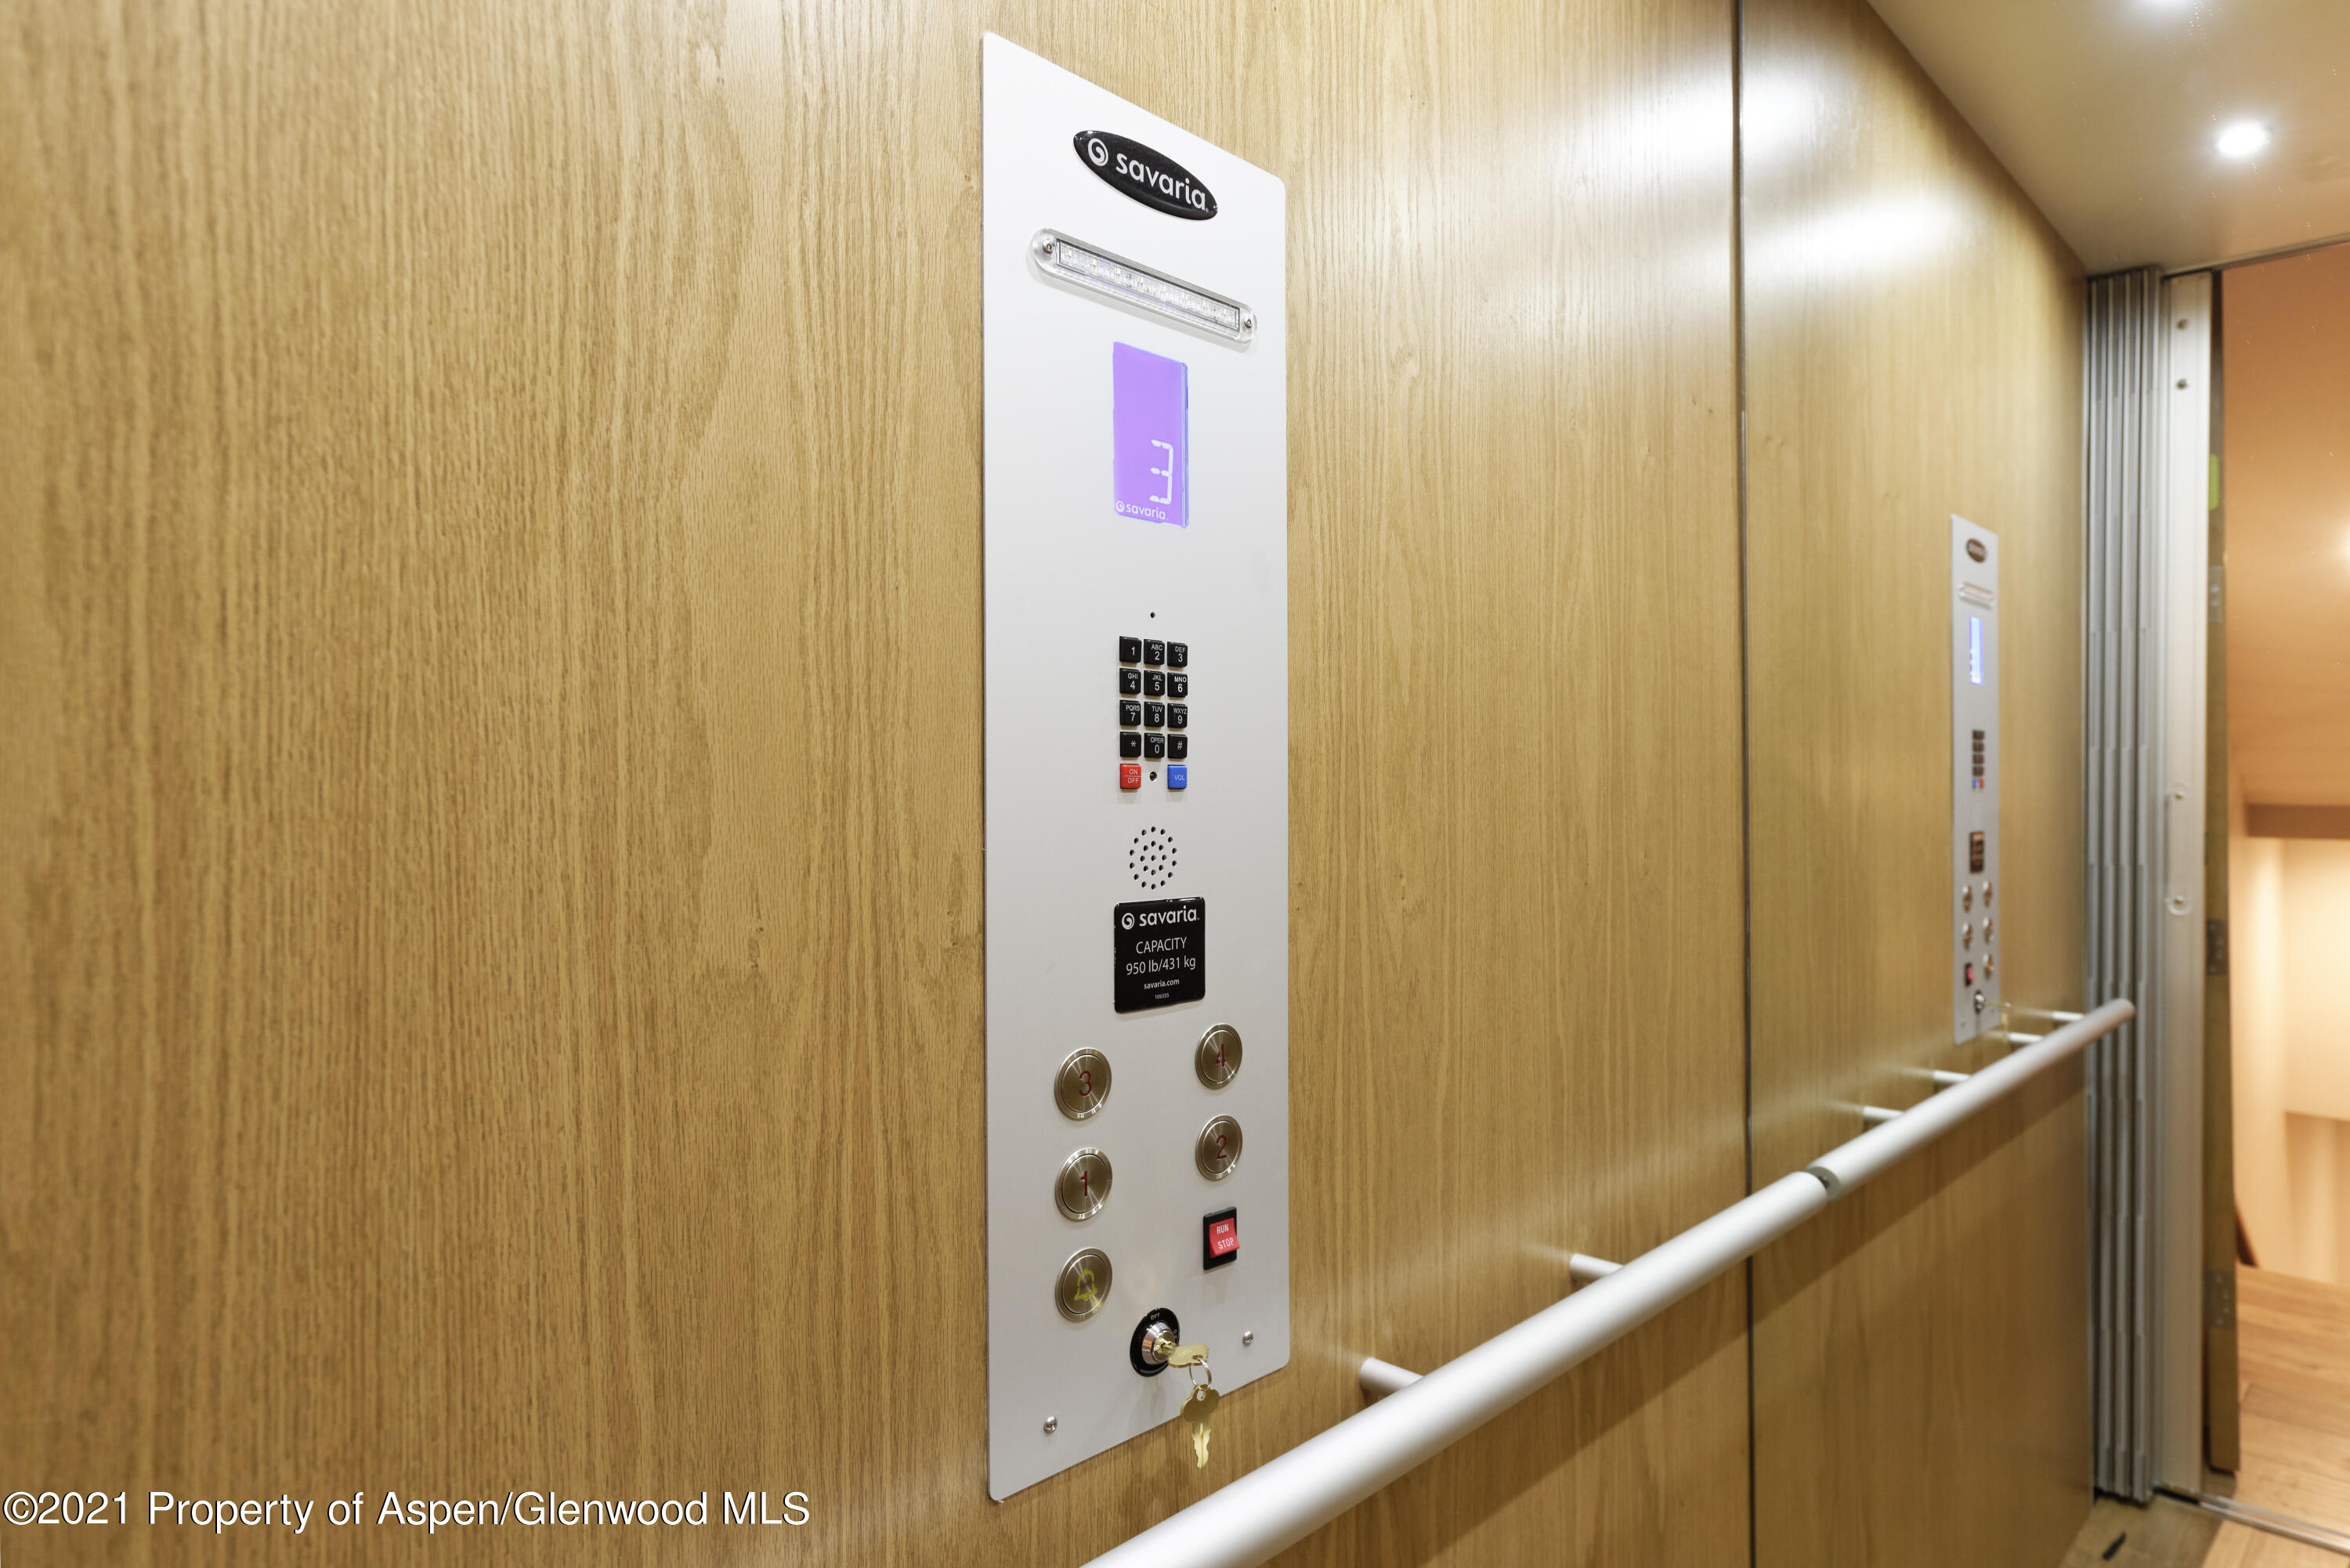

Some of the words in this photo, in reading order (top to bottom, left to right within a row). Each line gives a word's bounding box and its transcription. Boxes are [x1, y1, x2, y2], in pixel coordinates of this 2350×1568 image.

[1115, 152, 1206, 211] savaria
[1148, 439, 1174, 505] 3
[1126, 503, 1166, 520] savaria
[1130, 646, 1135, 656] 1
[1155, 651, 1160, 660] 2
[1177, 653, 1183, 663] 3
[1130, 681, 1136, 690] 4
[1155, 681, 1160, 691] 5
[1177, 683, 1183, 692] 6
[1130, 712, 1136, 721] 7
[1154, 714, 1159, 723] 8
[1177, 715, 1183, 724] 9
[1139, 905, 1197, 927] savaria
[1136, 937, 1188, 954] CAPACITY
[1126, 961, 1146, 976] 950
[1148, 957, 1180, 973] lb/431
[1184, 956, 1196, 970] kg
[1144, 978, 1180, 990] savaria.com
[1215, 1043, 1227, 1068] 4
[1079, 1070, 1092, 1097] 3
[1216, 1134, 1227, 1160] 2
[1080, 1170, 1088, 1198] 1
[1217, 1223, 1229, 1234] RUN
[1218, 1237, 1234, 1249] STOP
